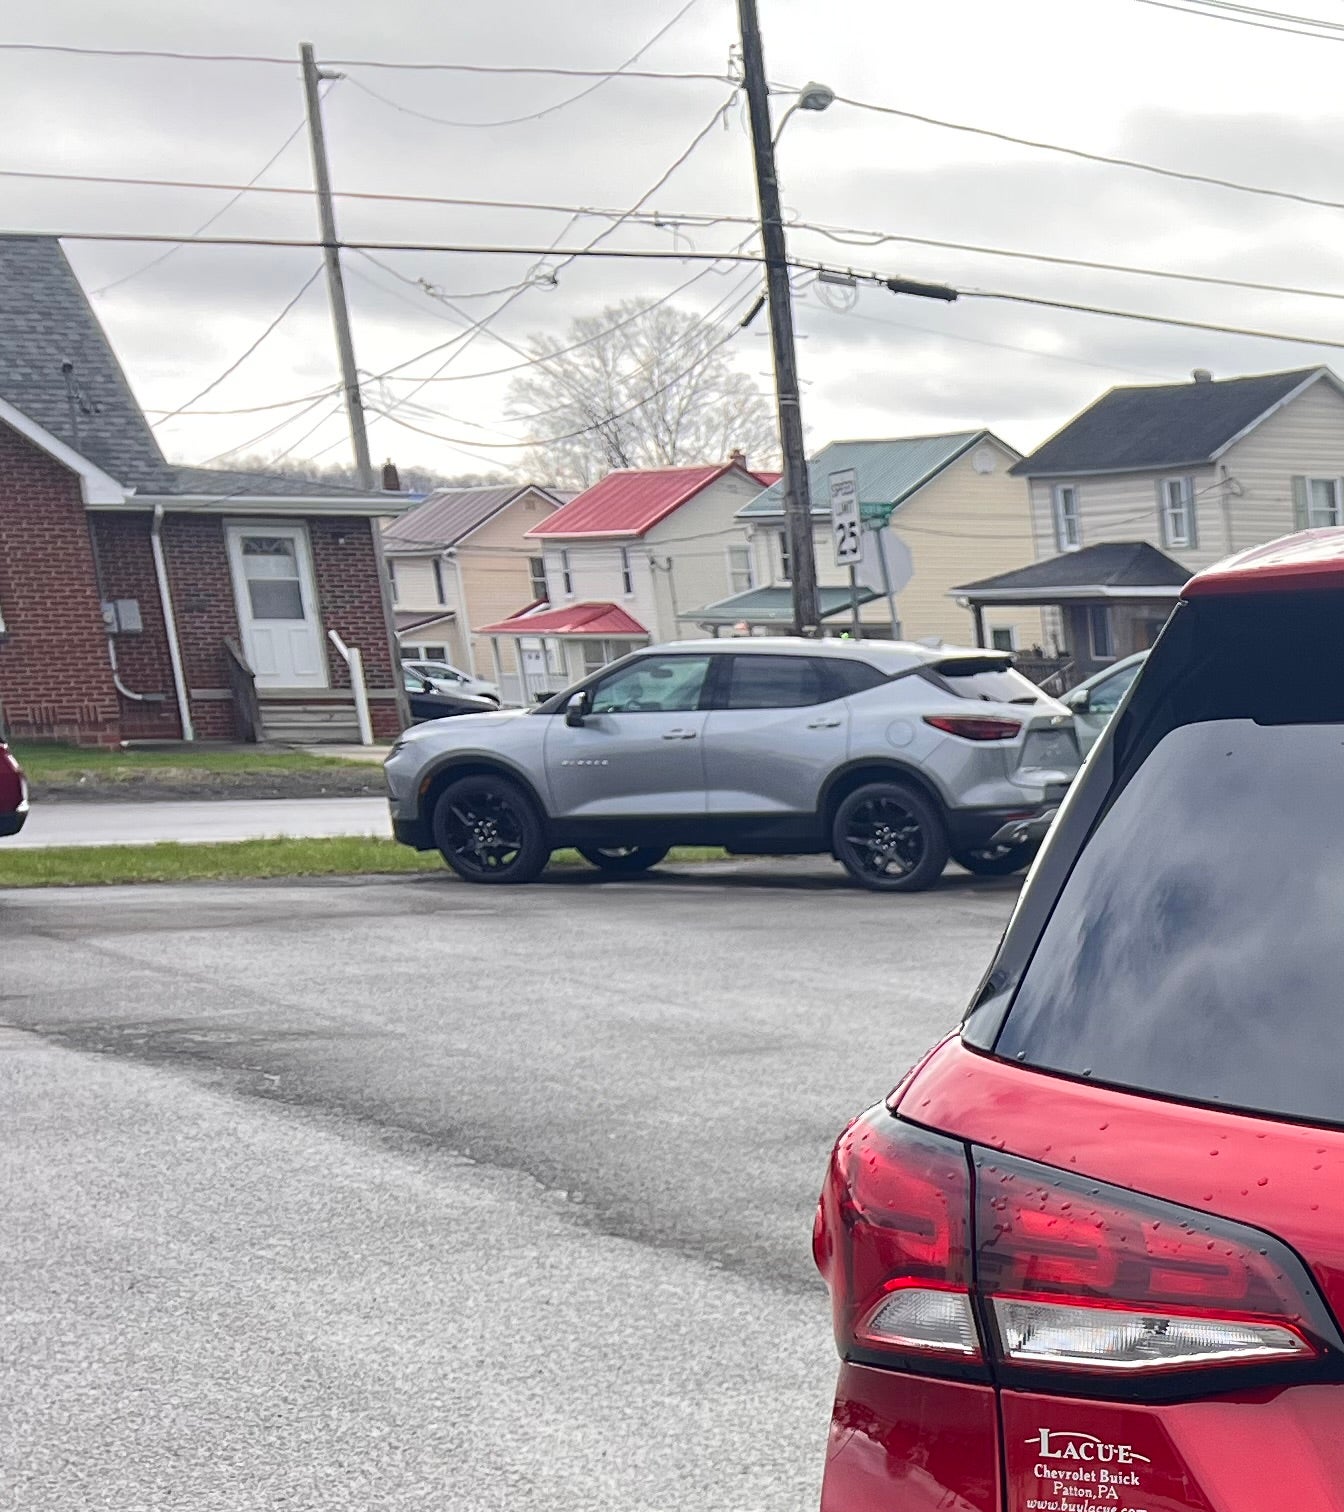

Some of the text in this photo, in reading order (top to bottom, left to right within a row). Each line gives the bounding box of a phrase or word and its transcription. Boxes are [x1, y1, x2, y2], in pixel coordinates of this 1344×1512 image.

[837, 521, 858, 555] 25
[1038, 1427, 1133, 1464] LACUE
[1033, 1463, 1140, 1486] Chevrolet Buick
